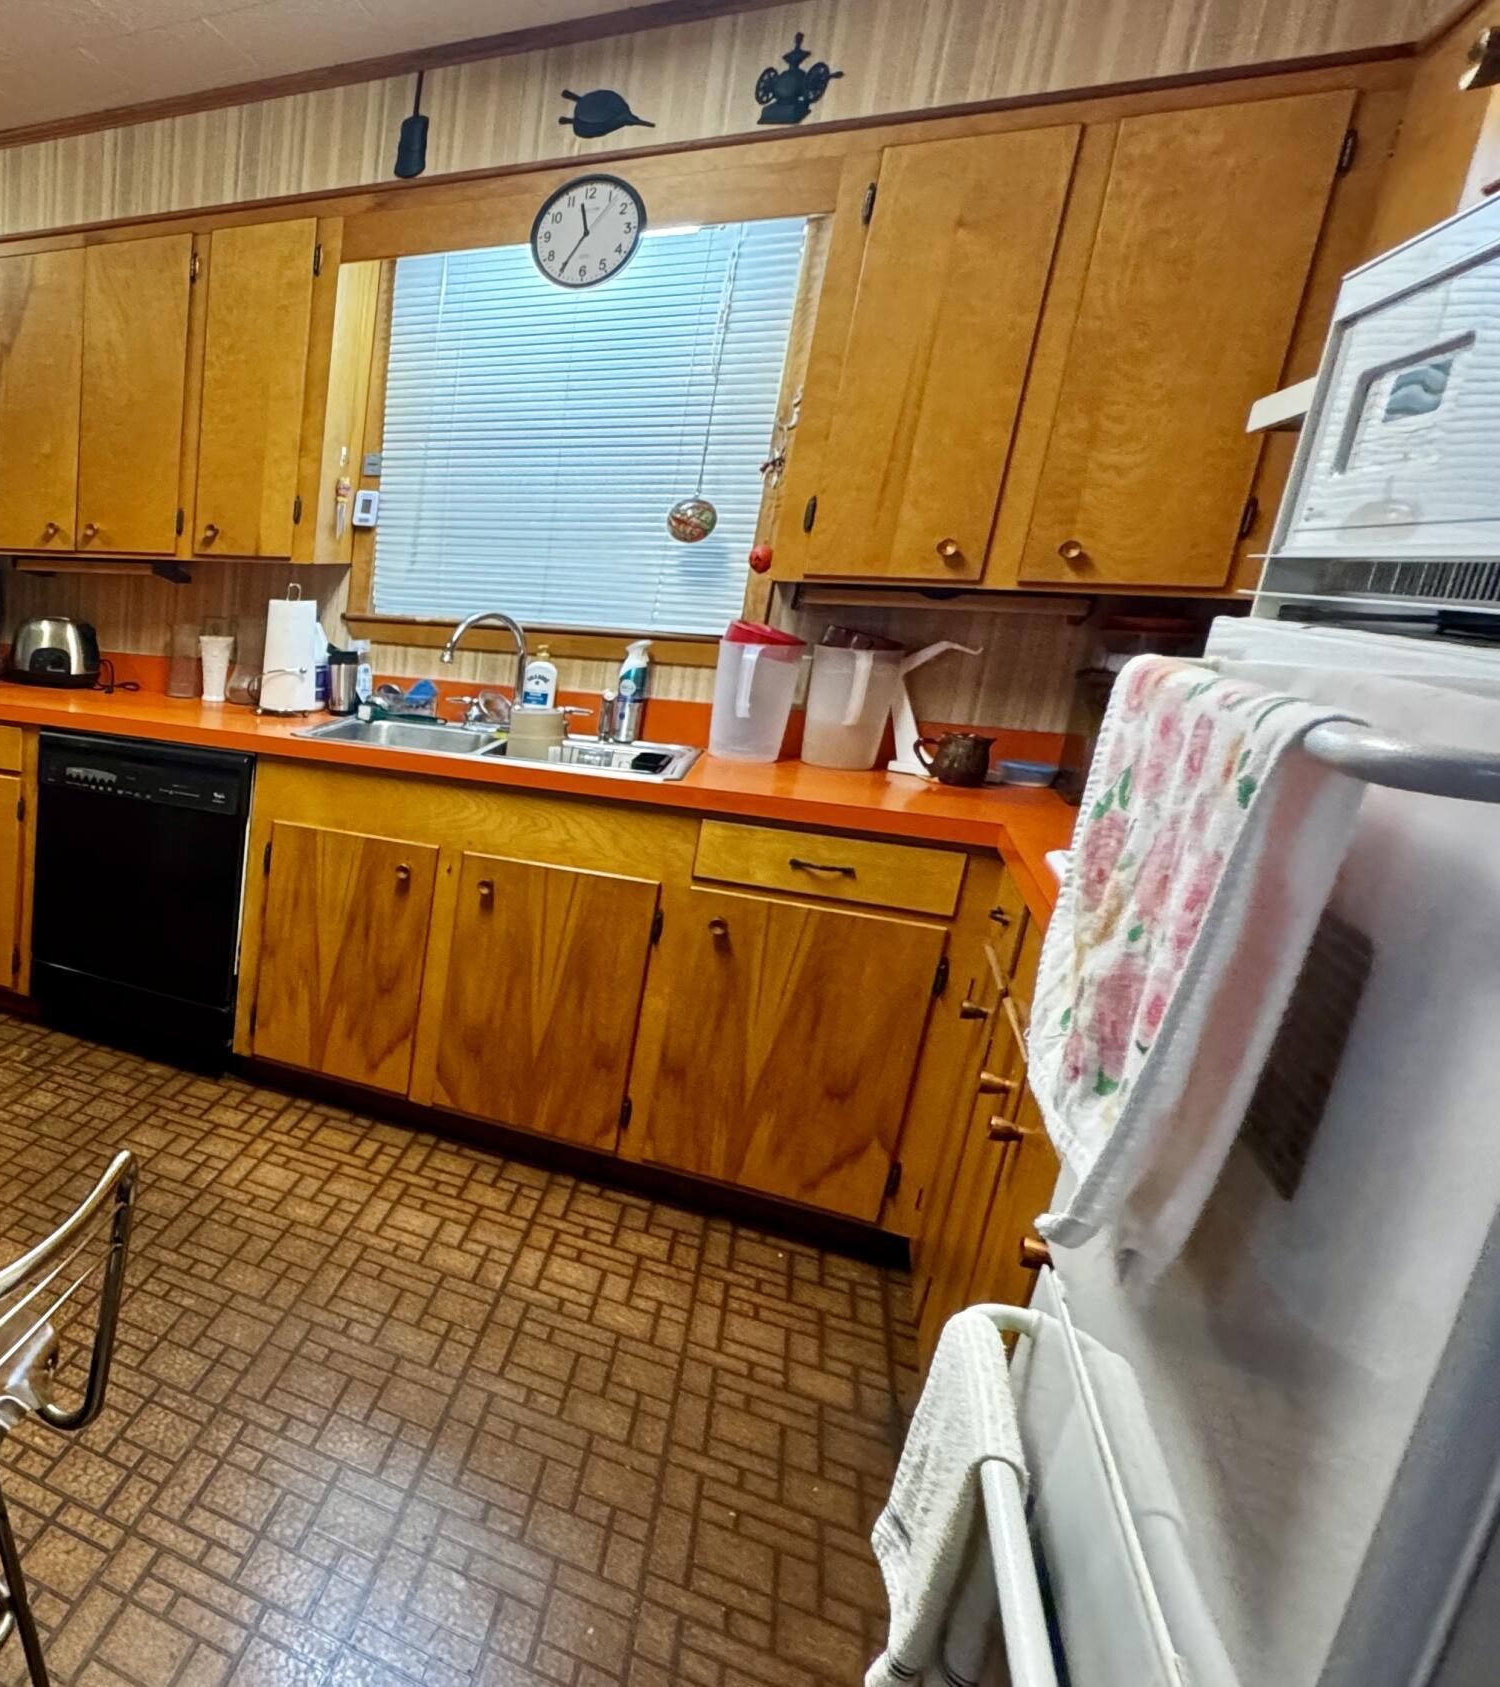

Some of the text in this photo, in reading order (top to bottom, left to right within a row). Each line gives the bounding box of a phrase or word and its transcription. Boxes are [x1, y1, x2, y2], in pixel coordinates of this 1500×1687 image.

[585, 187, 597, 200] 12
[567, 195, 576, 208] 11
[619, 202, 628, 215] 2
[551, 211, 563, 224] 10
[623, 221, 632, 234] 3
[543, 231, 552, 243] 9
[547, 249, 556, 262] 8
[614, 243, 622, 255] 4
[578, 265, 587, 277] 6
[598, 258, 607, 271] 5
